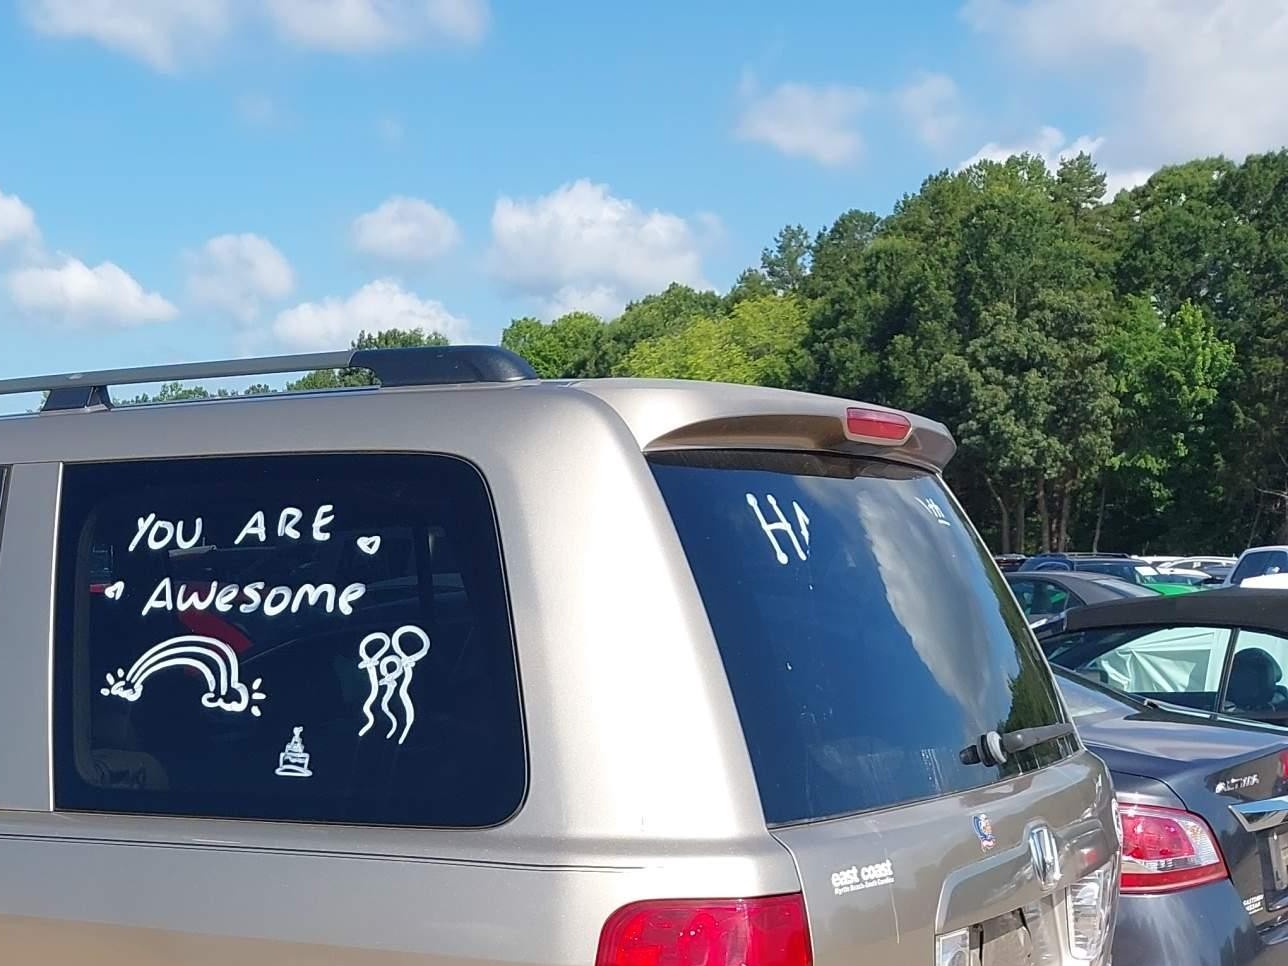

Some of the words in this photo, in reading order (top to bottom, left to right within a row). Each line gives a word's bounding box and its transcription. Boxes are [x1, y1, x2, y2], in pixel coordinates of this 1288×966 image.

[127, 512, 203, 552] YOU
[234, 504, 335, 546] ARE
[831, 866, 860, 887] east
[861, 859, 894, 881] coast
